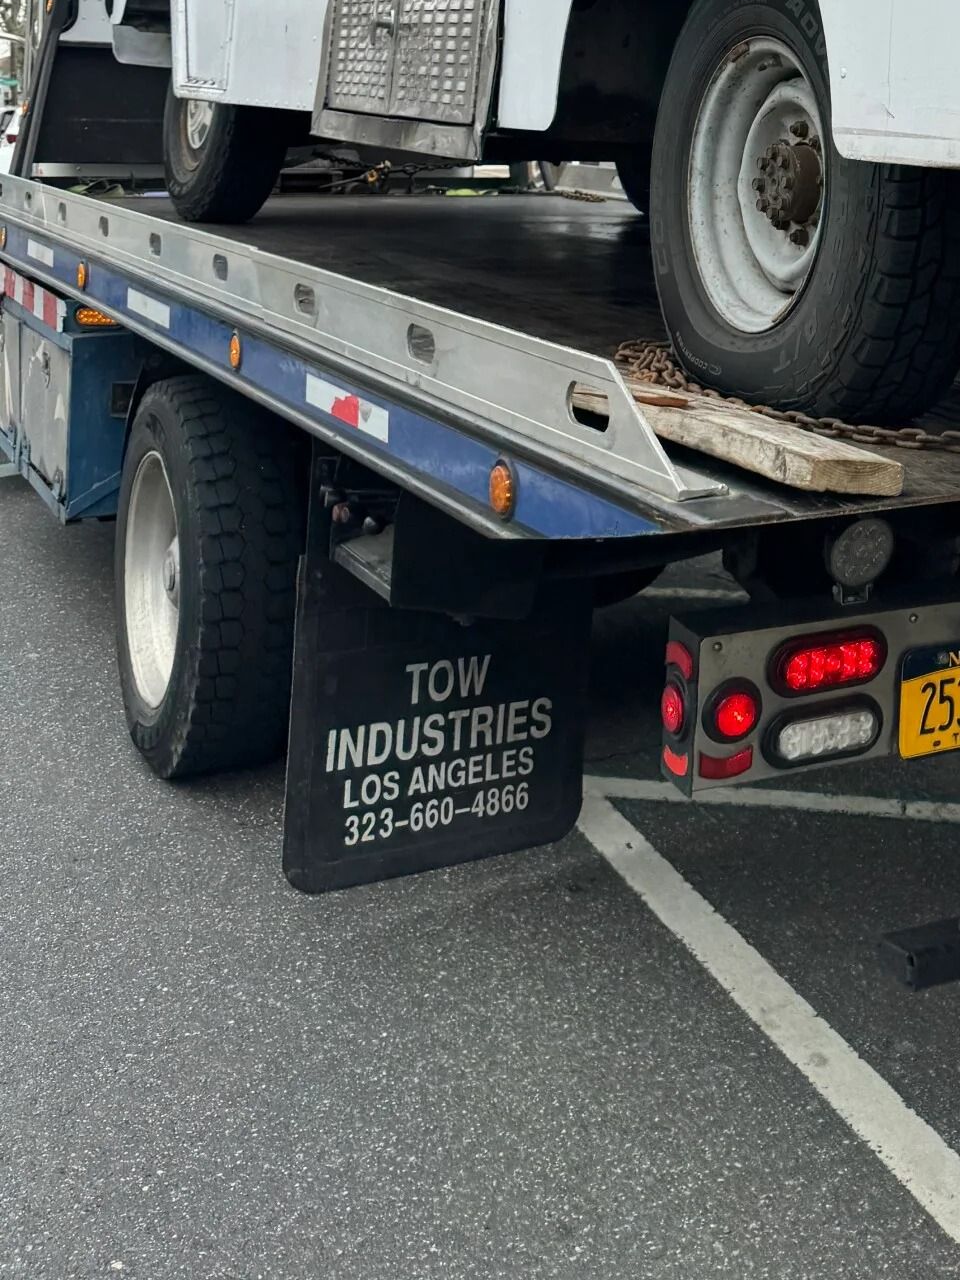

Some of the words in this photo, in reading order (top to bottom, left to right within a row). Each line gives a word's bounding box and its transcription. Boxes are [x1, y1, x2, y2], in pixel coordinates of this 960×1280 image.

[405, 654, 492, 705] TOW
[325, 696, 553, 773] INDUSTRIES
[343, 771, 400, 809] LOS
[407, 746, 535, 797] ANGELES
[344, 782, 530, 847] 323-660-4866
